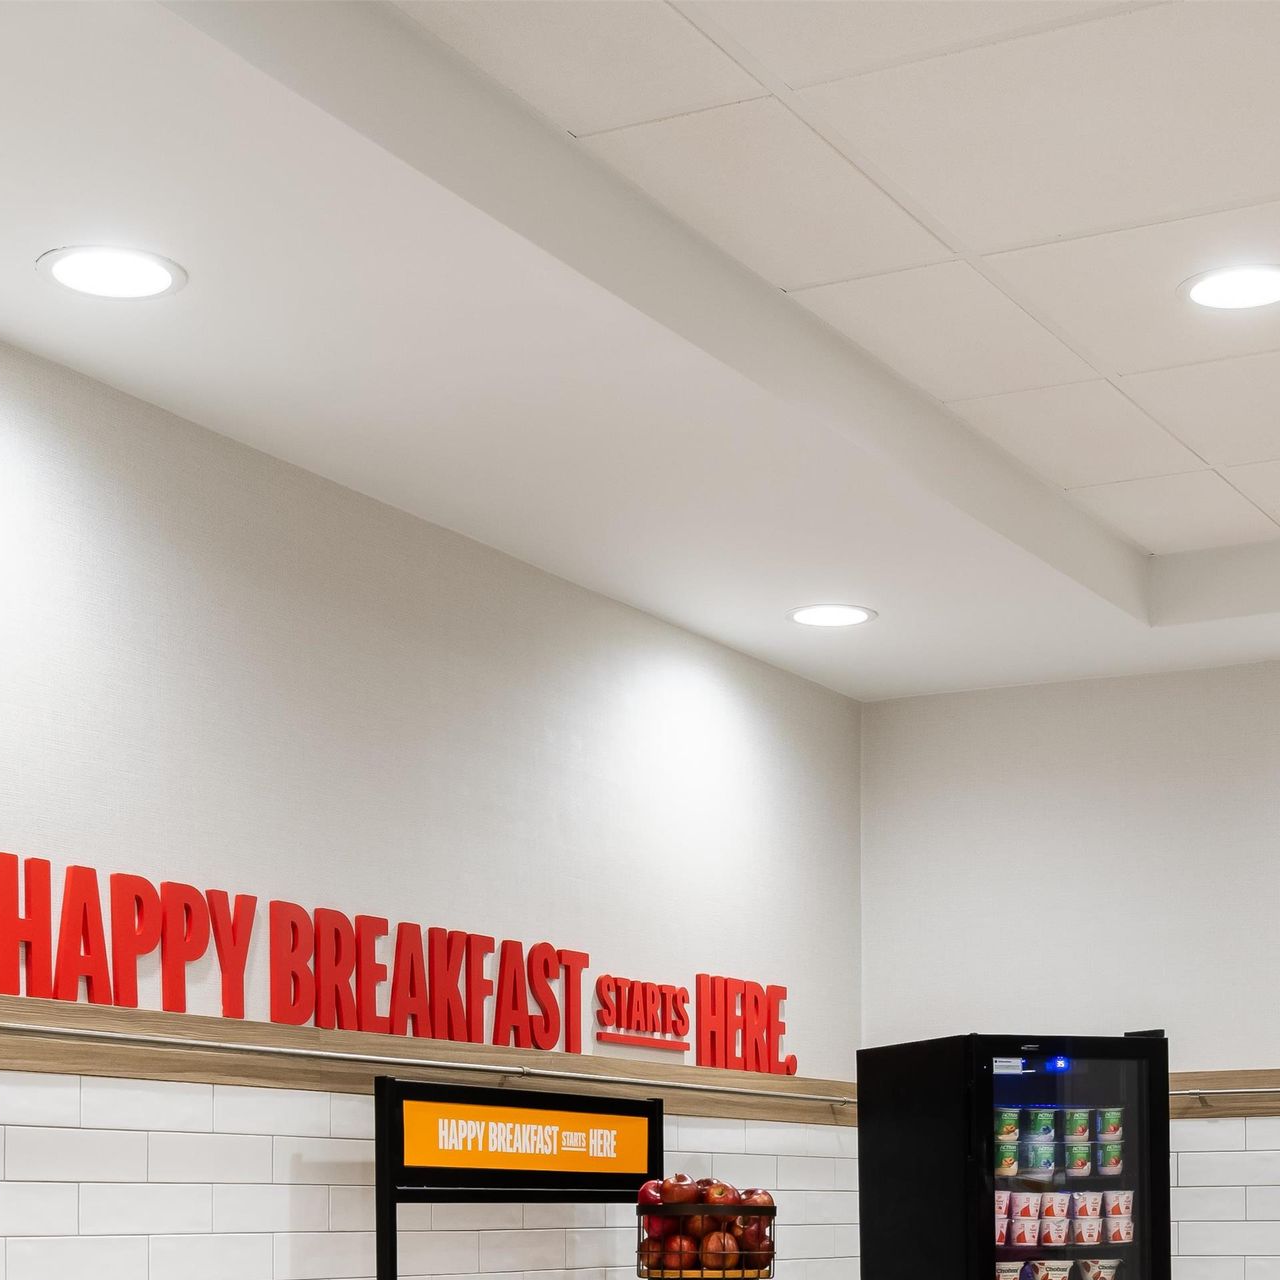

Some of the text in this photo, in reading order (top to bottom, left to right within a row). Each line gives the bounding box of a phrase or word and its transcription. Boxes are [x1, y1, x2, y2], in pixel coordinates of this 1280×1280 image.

[269, 899, 590, 1054] BREAKFAST
[596, 973, 691, 1037] STARTS
[696, 973, 798, 1077] HERE.
[438, 1118, 617, 1158] HAPPY BREAKFAST STARTS HERE
